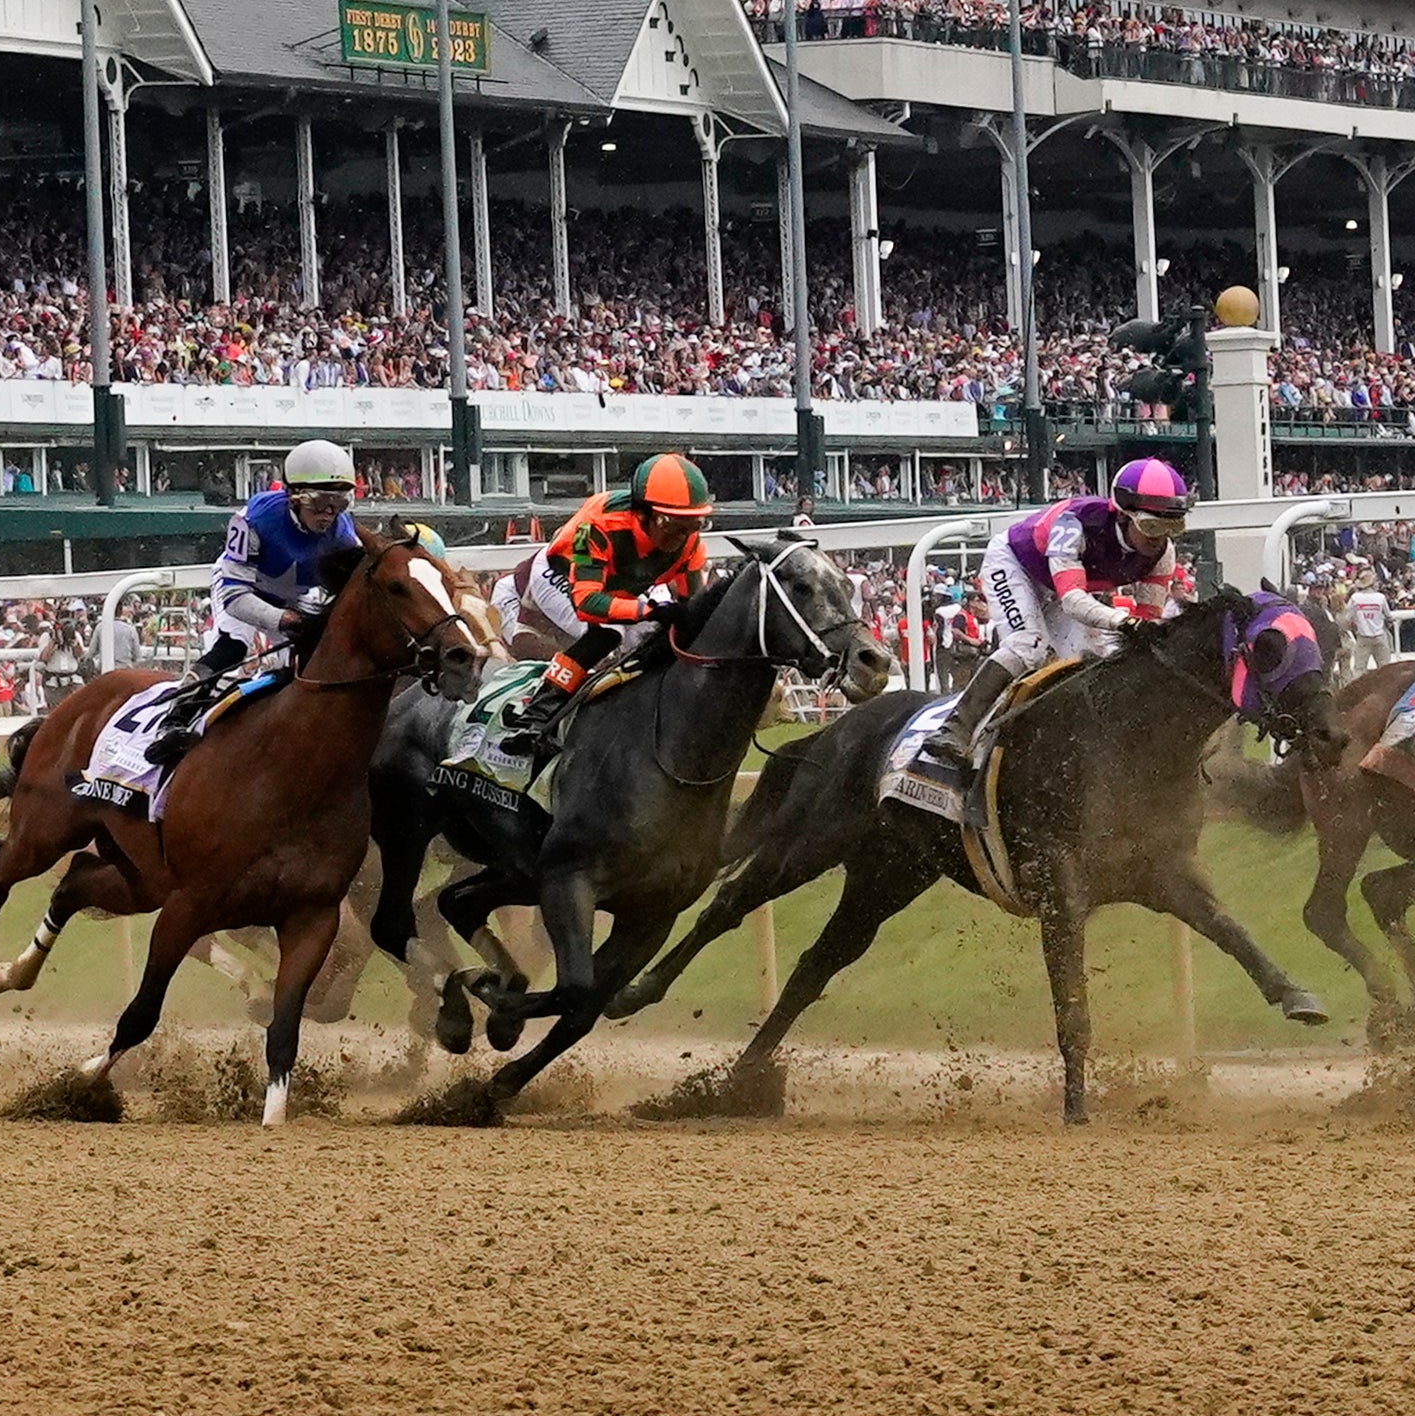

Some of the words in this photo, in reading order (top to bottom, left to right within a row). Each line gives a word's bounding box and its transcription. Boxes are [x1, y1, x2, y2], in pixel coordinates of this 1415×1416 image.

[346, 8, 372, 26] FIRST
[374, 12, 402, 30] DERBY
[449, 20, 481, 38] DERBY
[353, 28, 398, 56] 1875
[228, 526, 246, 555] 21
[1047, 525, 1082, 553] 22
[548, 661, 574, 685] RB
